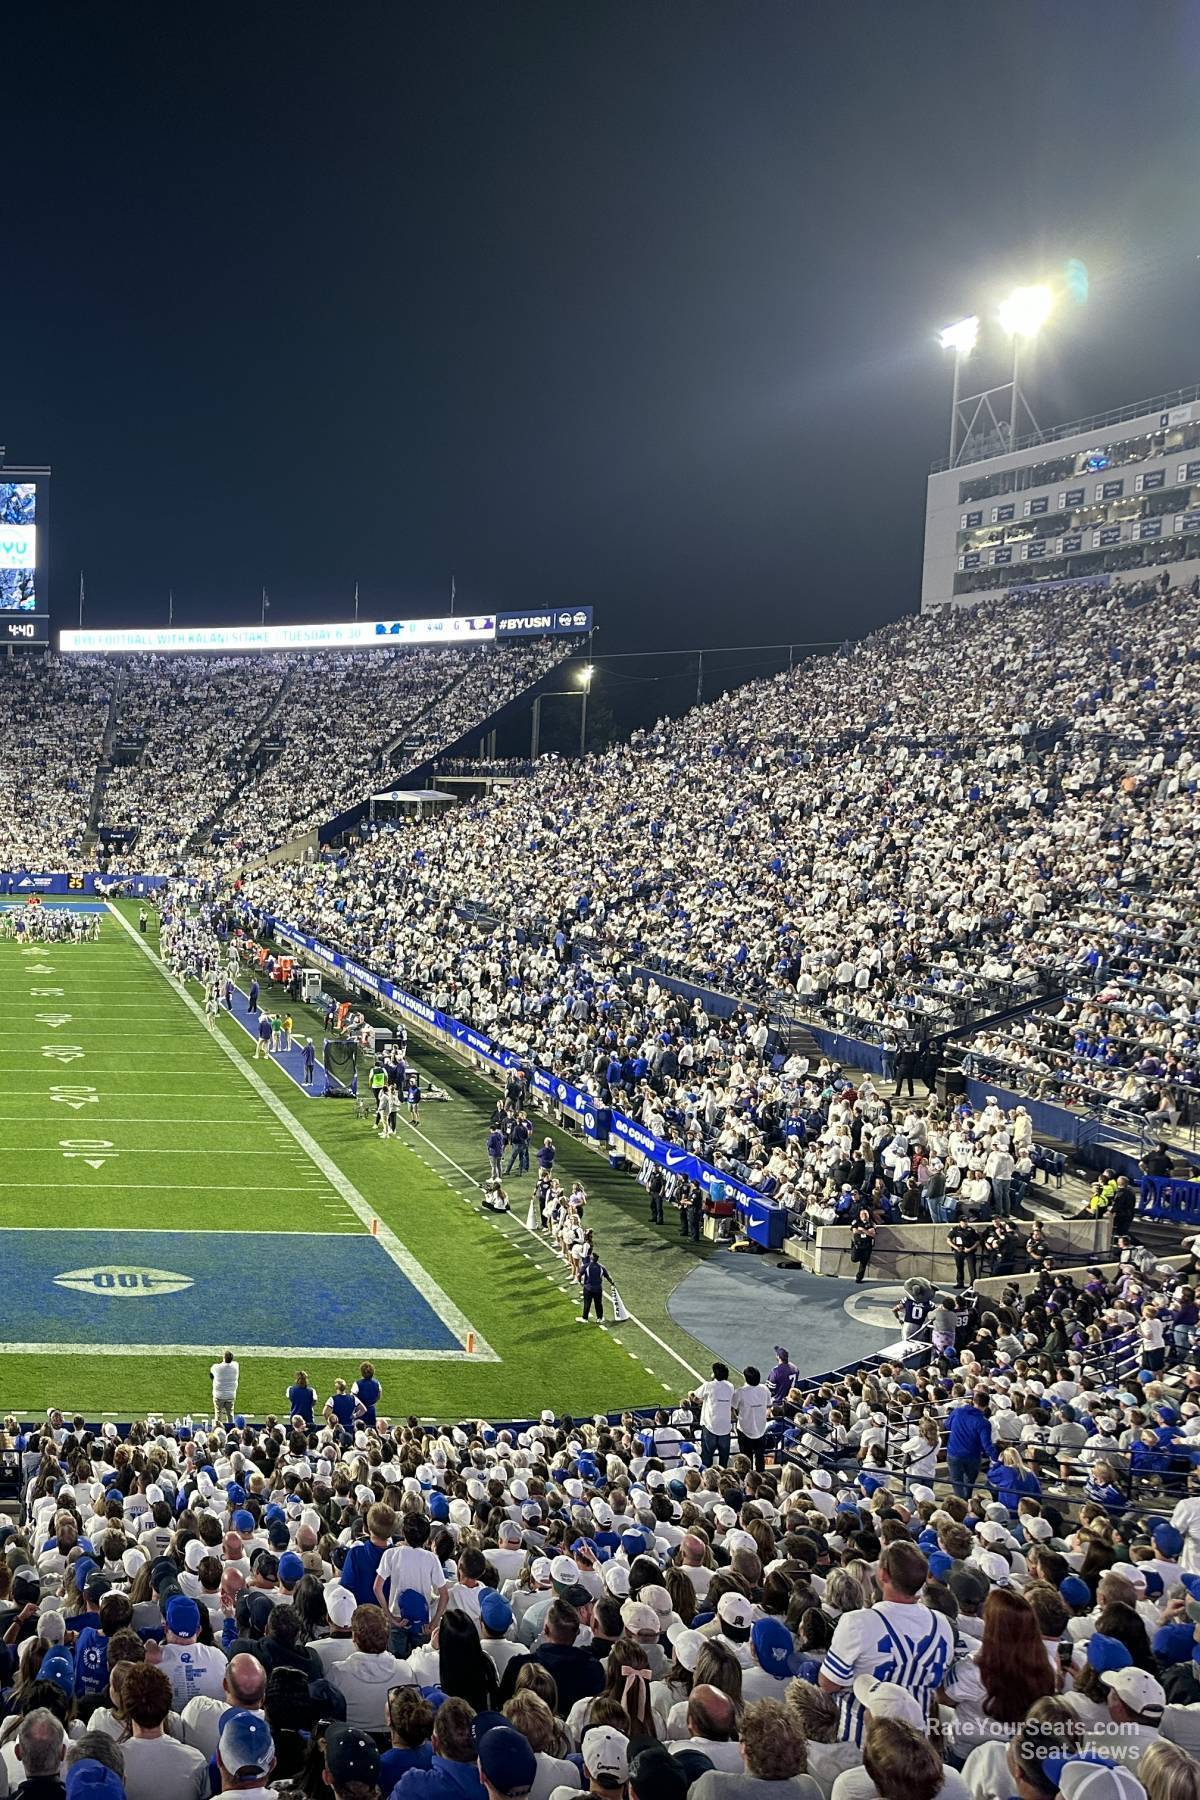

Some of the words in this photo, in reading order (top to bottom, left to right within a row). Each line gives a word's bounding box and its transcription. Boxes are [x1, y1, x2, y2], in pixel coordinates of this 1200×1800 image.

[8, 624, 35, 637] 4:40
[499, 616, 551, 631] #BYUSN
[68, 878, 83, 888] 25
[355, 967, 379, 989] FOOTBALL
[392, 989, 406, 1007] BYU
[405, 995, 435, 1022] COUGARS
[41, 1045, 86, 1058] 30
[49, 1085, 100, 1103] 20
[615, 1120, 629, 1134] GO
[58, 1139, 120, 1158] 10
[93, 1272, 149, 1288] 100
[911, 1306, 923, 1320] 0
